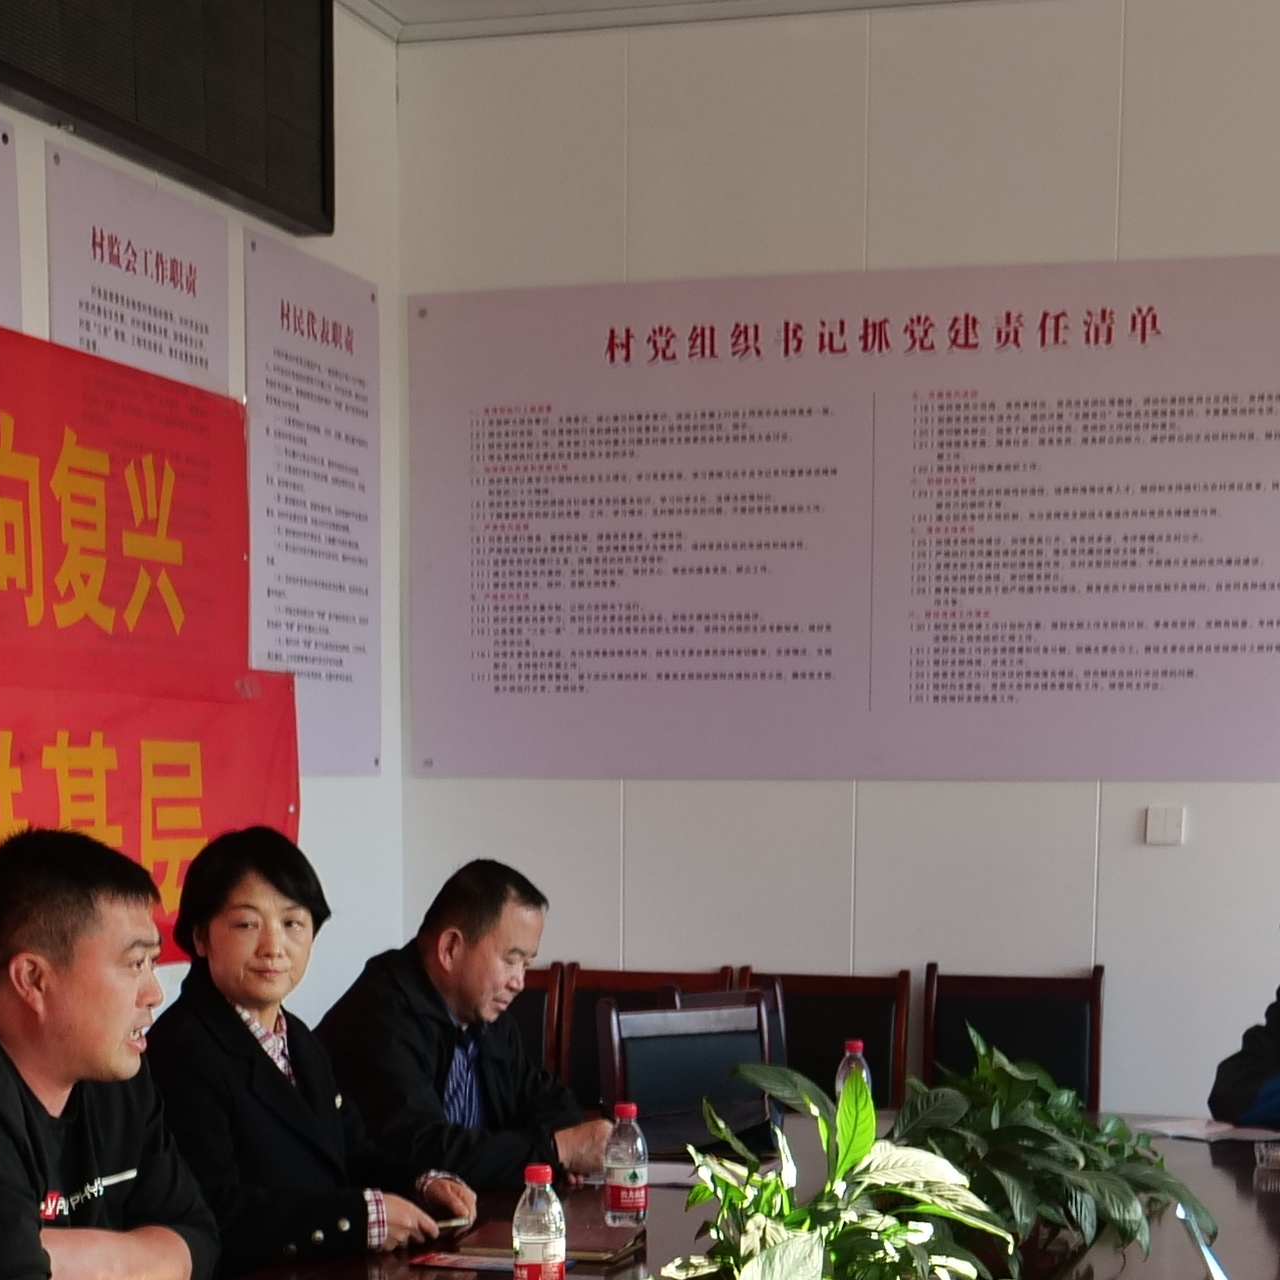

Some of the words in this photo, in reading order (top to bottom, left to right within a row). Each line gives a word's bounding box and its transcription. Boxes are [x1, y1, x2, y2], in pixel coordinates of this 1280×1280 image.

[91, 225, 198, 299] 村监会工作职责
[280, 298, 355, 356] 村民代表职责
[604, 304, 1164, 367] 村党组织书记抓党建责任清单
